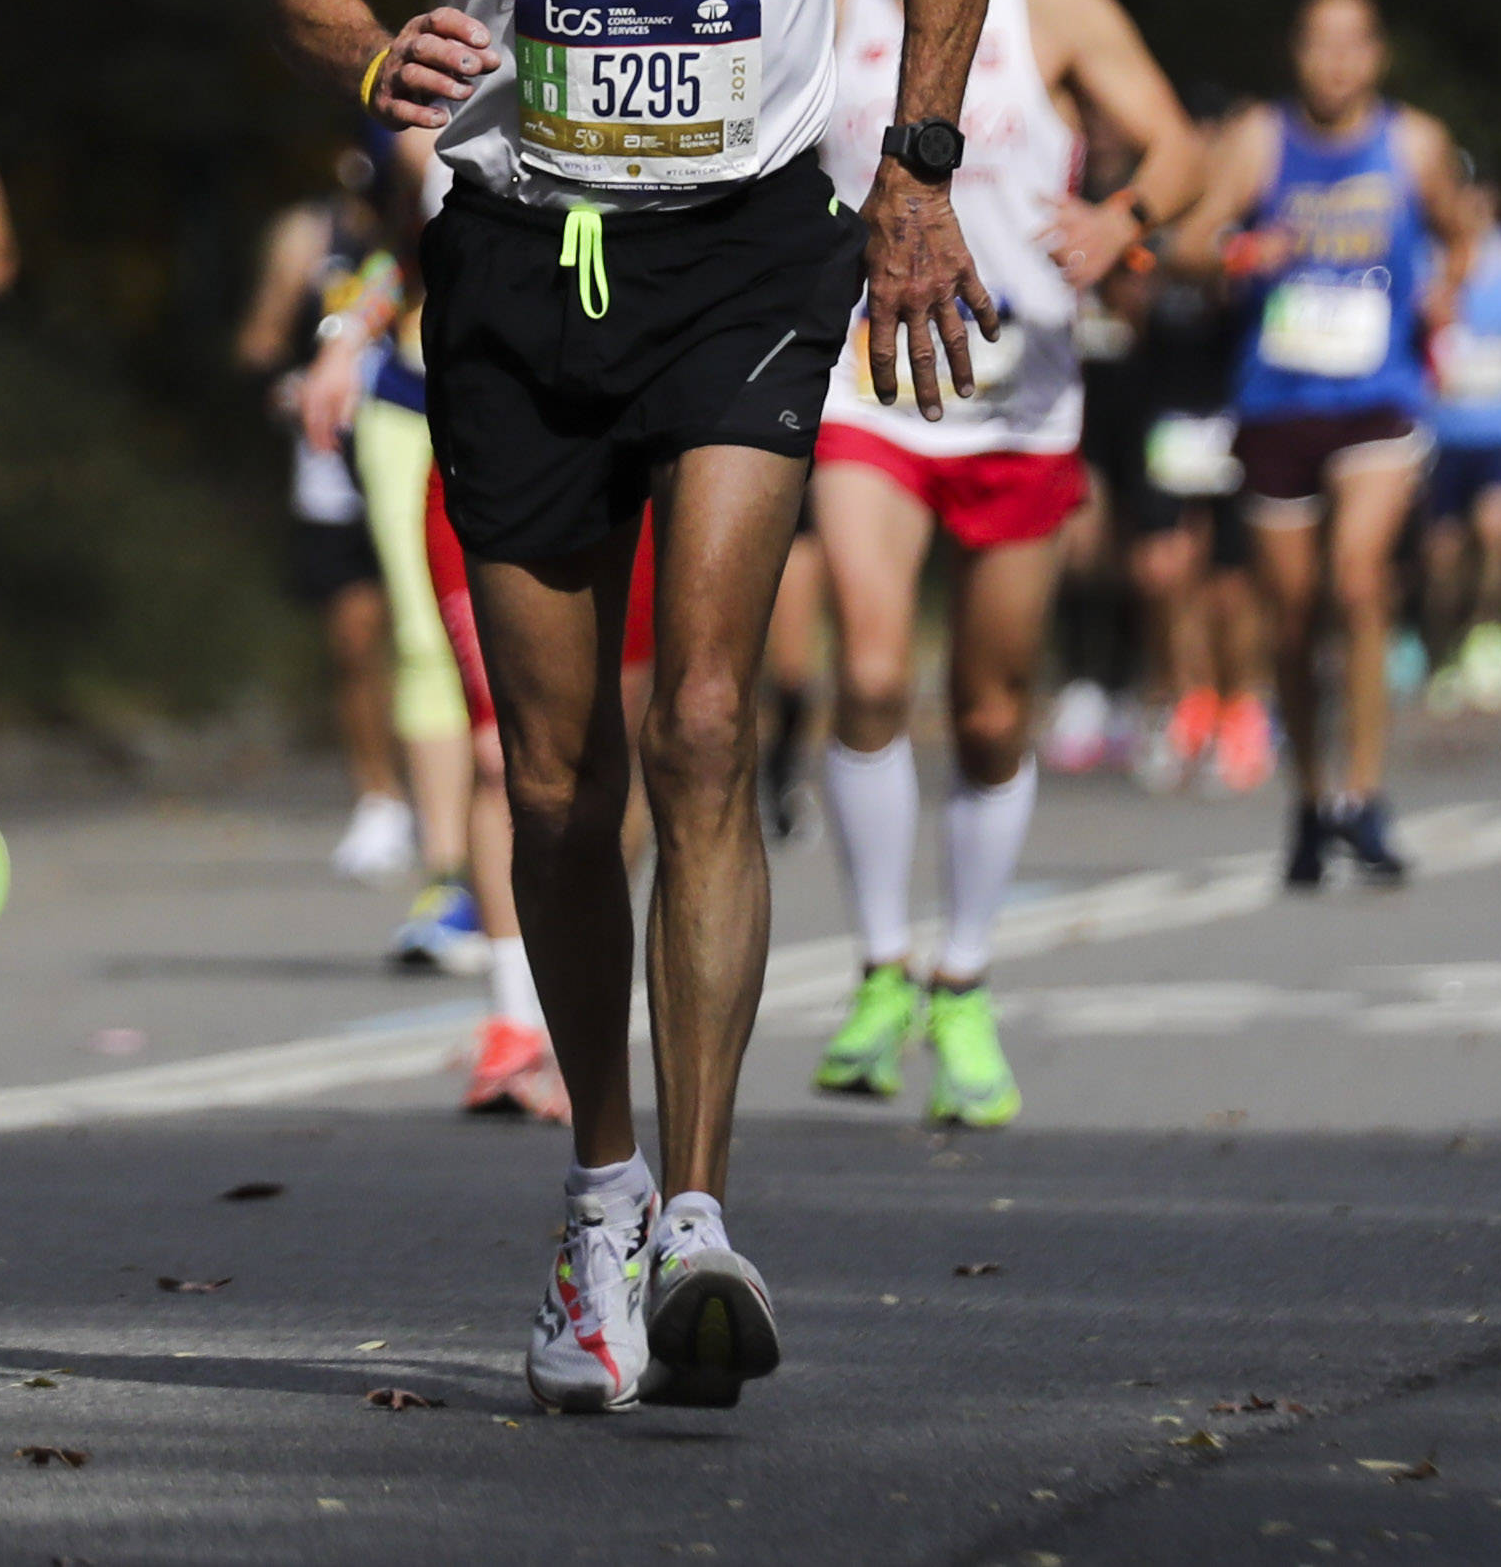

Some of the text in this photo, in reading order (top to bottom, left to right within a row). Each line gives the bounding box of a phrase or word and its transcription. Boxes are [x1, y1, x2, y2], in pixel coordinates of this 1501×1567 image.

[608, 7, 636, 16] TATA
[607, 15, 673, 26] CONSULTANCY
[607, 25, 650, 36] SERVICES
[691, 21, 733, 34] TATA
[592, 52, 700, 118] 5295
[730, 57, 745, 101] 2021
